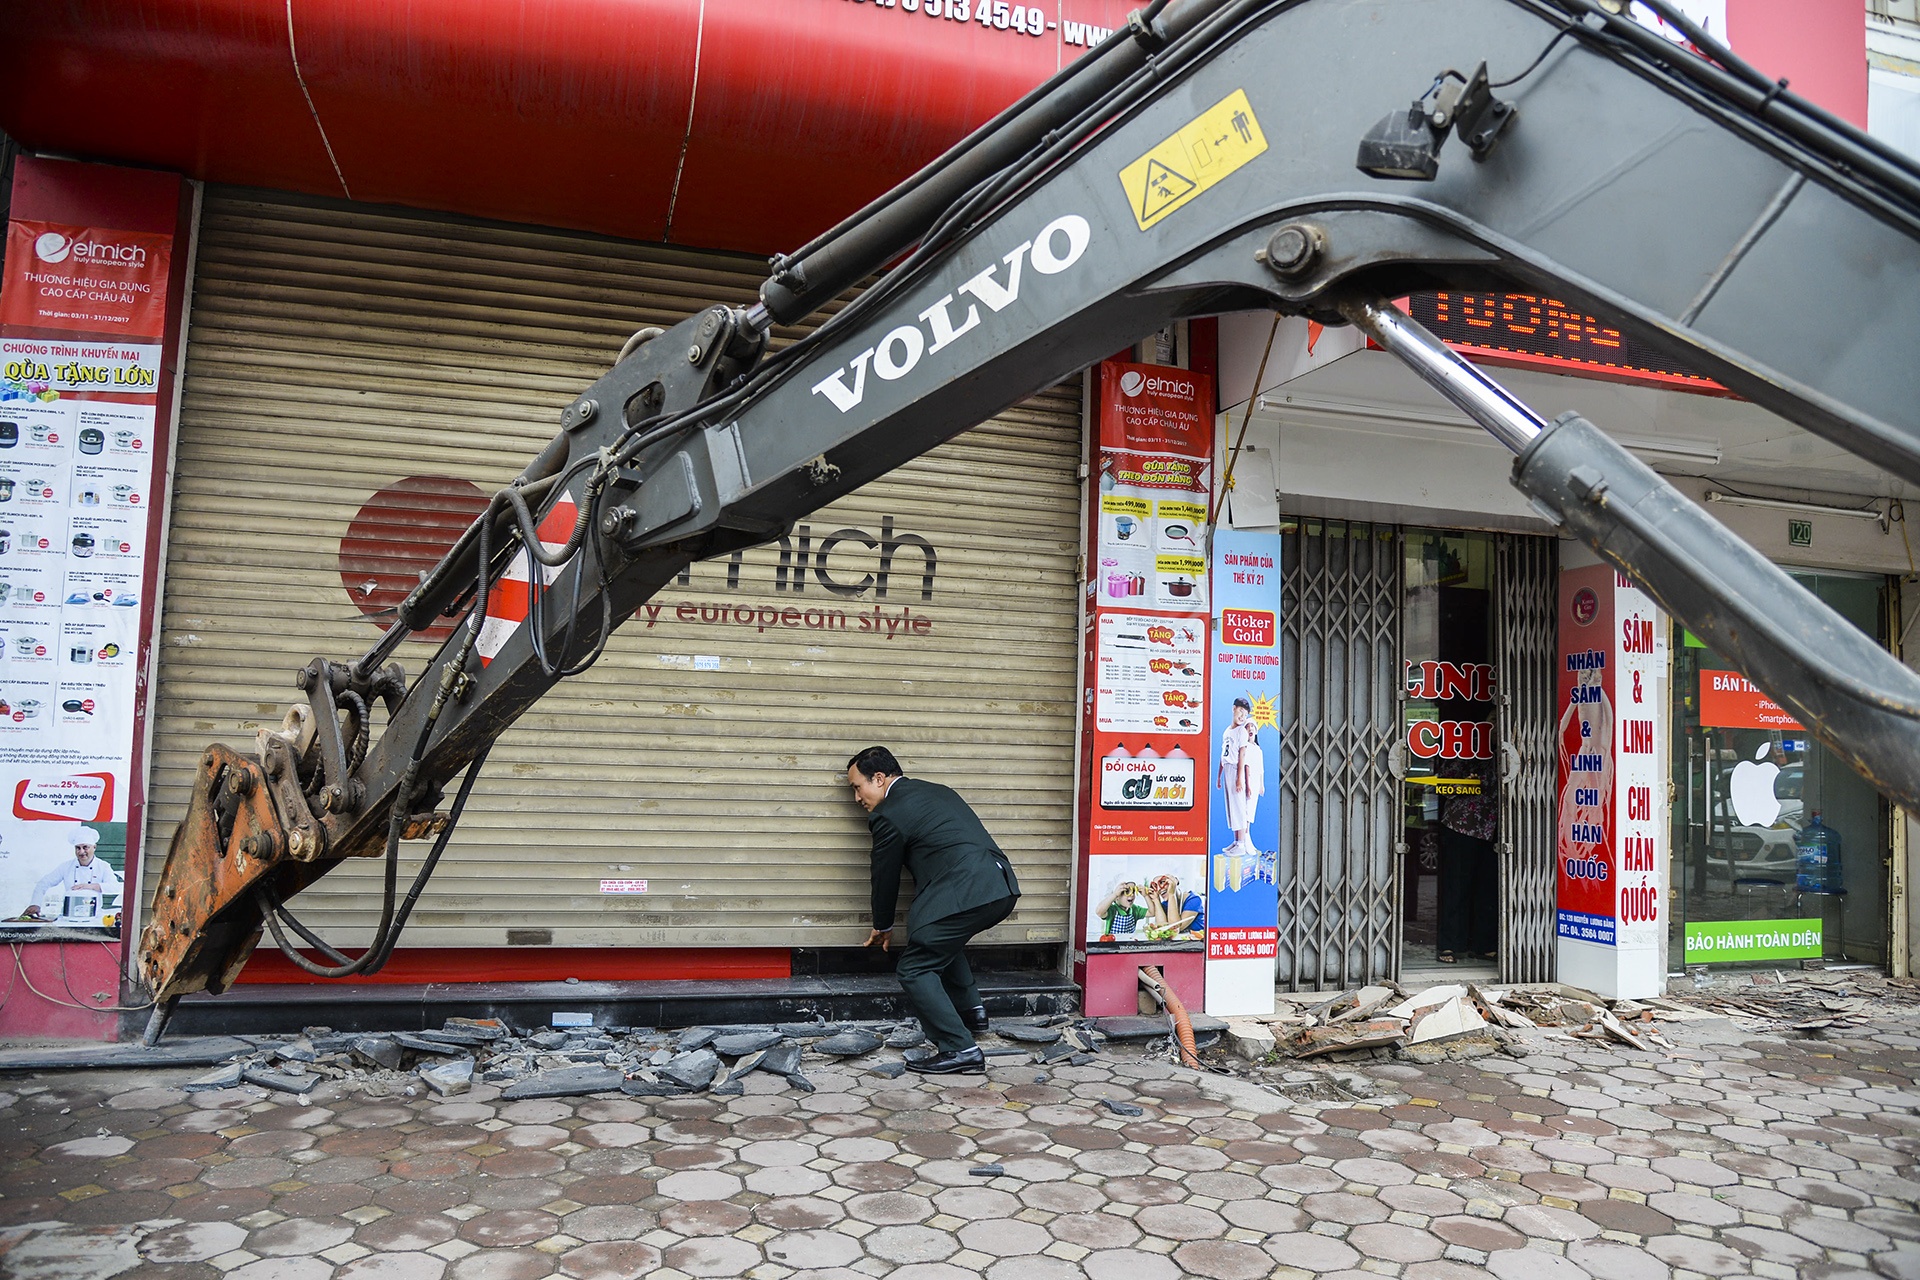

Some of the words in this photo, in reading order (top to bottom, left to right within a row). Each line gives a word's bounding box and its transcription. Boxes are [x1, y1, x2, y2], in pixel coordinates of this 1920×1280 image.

[975, 2, 1044, 36] 4549
[1063, 20, 1113, 47] ww
[73, 240, 146, 262] elmich
[91, 258, 127, 267] european
[128, 261, 145, 269] style
[24, 271, 71, 285] THƯƠNG
[73, 277, 97, 289] HIỆU
[99, 279, 117, 290] GIA
[120, 281, 151, 293] DỤNG
[40, 287, 64, 298] CAO
[65, 288, 87, 299] CẤP
[88, 291, 118, 302] CHÂU
[120, 293, 135, 304] ÂU
[811, 214, 1091, 413] VOLVO
[3, 342, 48, 355] CHƯƠNG
[51, 344, 79, 357] TRÌNH
[81, 346, 119, 360] KHUYẾN
[121, 350, 140, 363] MẠI
[54, 361, 109, 386] TẶNG
[114, 364, 154, 386] LỚN
[1146, 377, 1195, 396] elmich
[1126, 416, 1142, 426] CAO
[1142, 416, 1158, 426] CẤP
[1164, 409, 1177, 419] GIA
[1119, 471, 1142, 482] THEO
[1792, 524, 1810, 540] 120
[1224, 550, 1238, 566] SẢN
[1239, 552, 1259, 568] PHẨM
[1260, 553, 1274, 568] CỦA
[1233, 569, 1245, 584] THẾ
[1247, 569, 1255, 585] KỶ
[1256, 574, 1264, 585] 21
[676, 601, 846, 633] european
[858, 605, 932, 640] style
[1226, 613, 1271, 629] Kicker
[1149, 630, 1171, 641] TẶNG
[1233, 628, 1264, 643] Gold
[1623, 612, 1653, 654] SÂM
[1151, 662, 1170, 671] TẶNG
[1566, 648, 1606, 671] NHÂN
[1252, 670, 1266, 680] CAO
[1713, 674, 1740, 692] BÁN
[1741, 678, 1760, 693] TR
[1571, 682, 1602, 704] SÂM
[1632, 670, 1643, 704] &
[1165, 694, 1184, 703] TẶNG
[1581, 719, 1592, 738] &
[1622, 719, 1653, 754] LINH
[1407, 720, 1494, 760] CHI
[1105, 758, 1124, 771] ĐỔI
[1126, 760, 1156, 772] CHẢO
[1571, 754, 1602, 772] LINH
[60, 780, 80, 789] 25%
[1122, 774, 1153, 799] CŨ
[1153, 783, 1187, 799] MỚI
[1156, 773, 1168, 782] LẤY
[1436, 786, 1454, 794] KEO
[1456, 786, 1481, 795] SANG
[1575, 788, 1598, 806] CHI
[1627, 785, 1650, 821] CHI
[1572, 820, 1602, 843] HÀN
[1624, 831, 1653, 871] HÀN
[1566, 854, 1608, 881] QUỐC
[1620, 875, 1657, 926] QUỐC
[1559, 923, 1570, 934] ĐT:
[1570, 925, 1580, 937] 04.
[1581, 927, 1597, 939] 3564
[1598, 929, 1614, 942] 0007
[1686, 931, 1714, 951] BẢO
[1716, 931, 1753, 949] HÀNH
[1755, 930, 1790, 948] TOÀN
[1792, 929, 1820, 950] DIỆN
[1211, 944, 1222, 956] ĐT:
[1224, 944, 1236, 956] 04.
[1237, 944, 1255, 955] 3564
[1257, 943, 1275, 955] 0007
